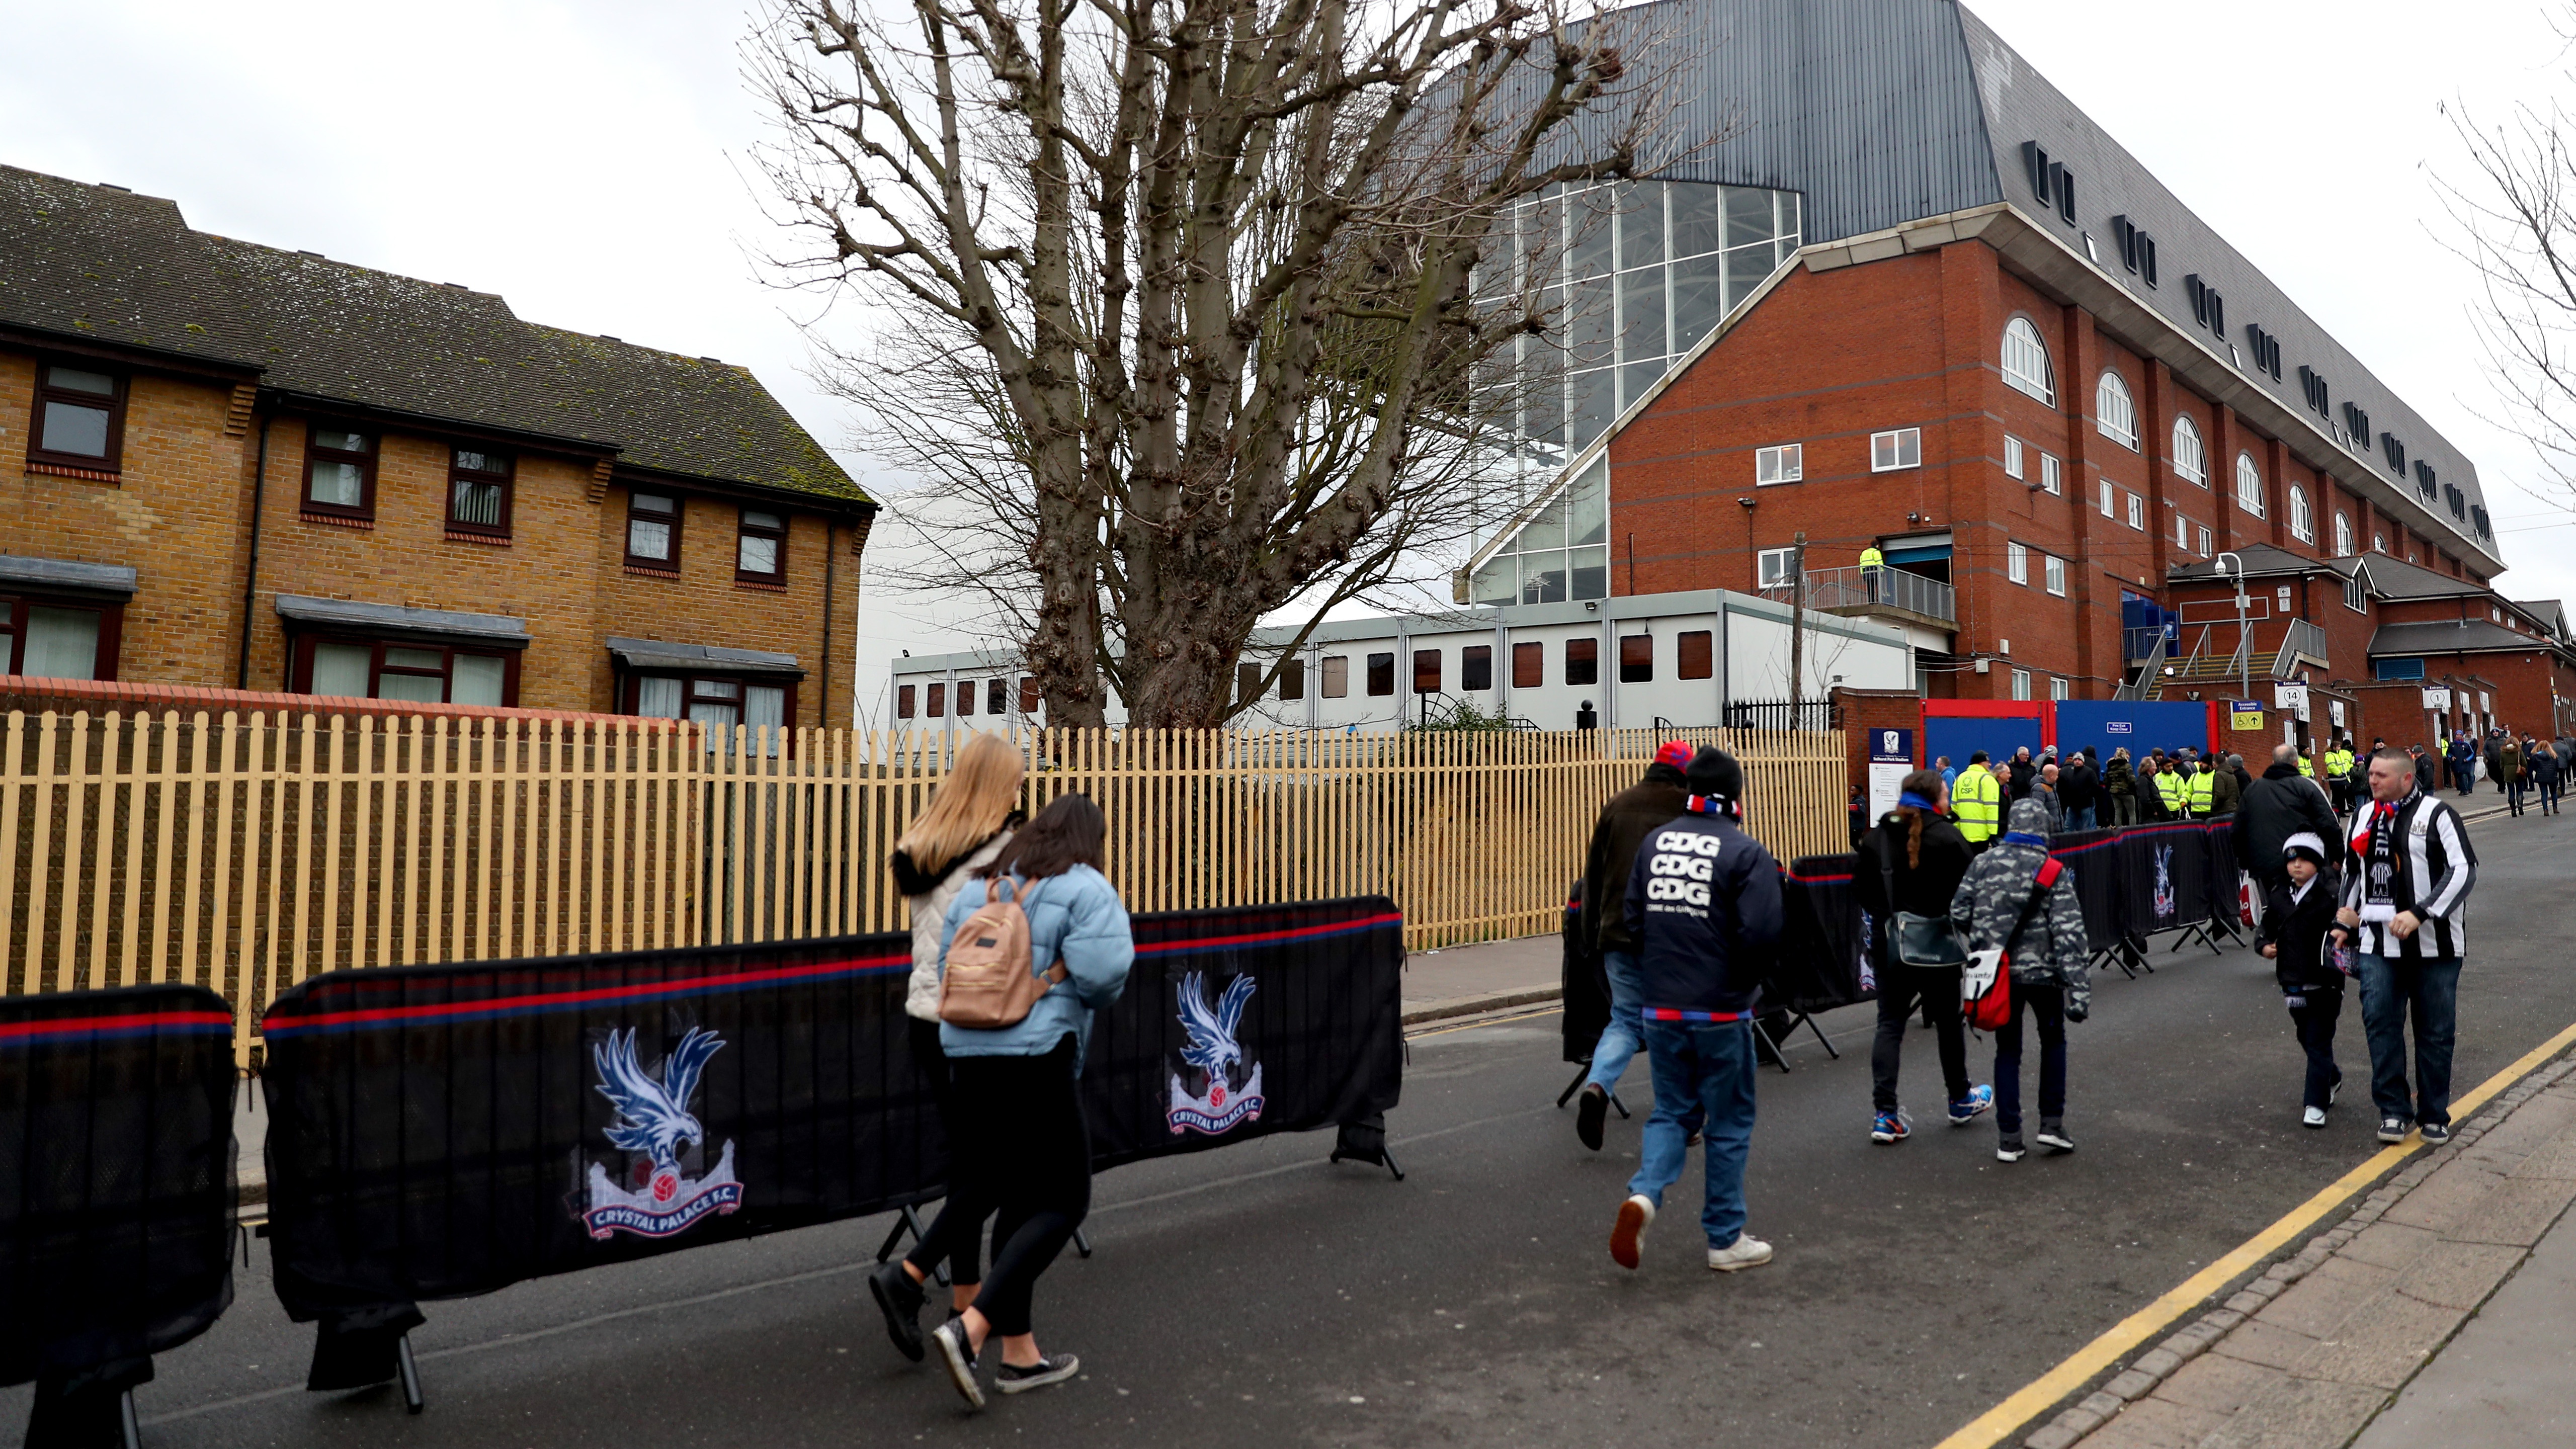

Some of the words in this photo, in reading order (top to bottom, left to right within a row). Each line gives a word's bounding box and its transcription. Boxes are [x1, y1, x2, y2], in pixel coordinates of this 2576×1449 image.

[2287, 692, 2297, 700] 14
[1655, 831, 1721, 858] CDG
[1650, 854, 1714, 882] CDG
[1646, 877, 1711, 906] CDG
[1173, 1111, 1211, 1130] CRYSTAL
[1213, 1104, 1244, 1130] PALACE
[1244, 1098, 1258, 1110] F.C.
[595, 1209, 656, 1231] CRYSTAL
[659, 1196, 712, 1230] PALACE
[712, 1187, 734, 1203] F.C.
